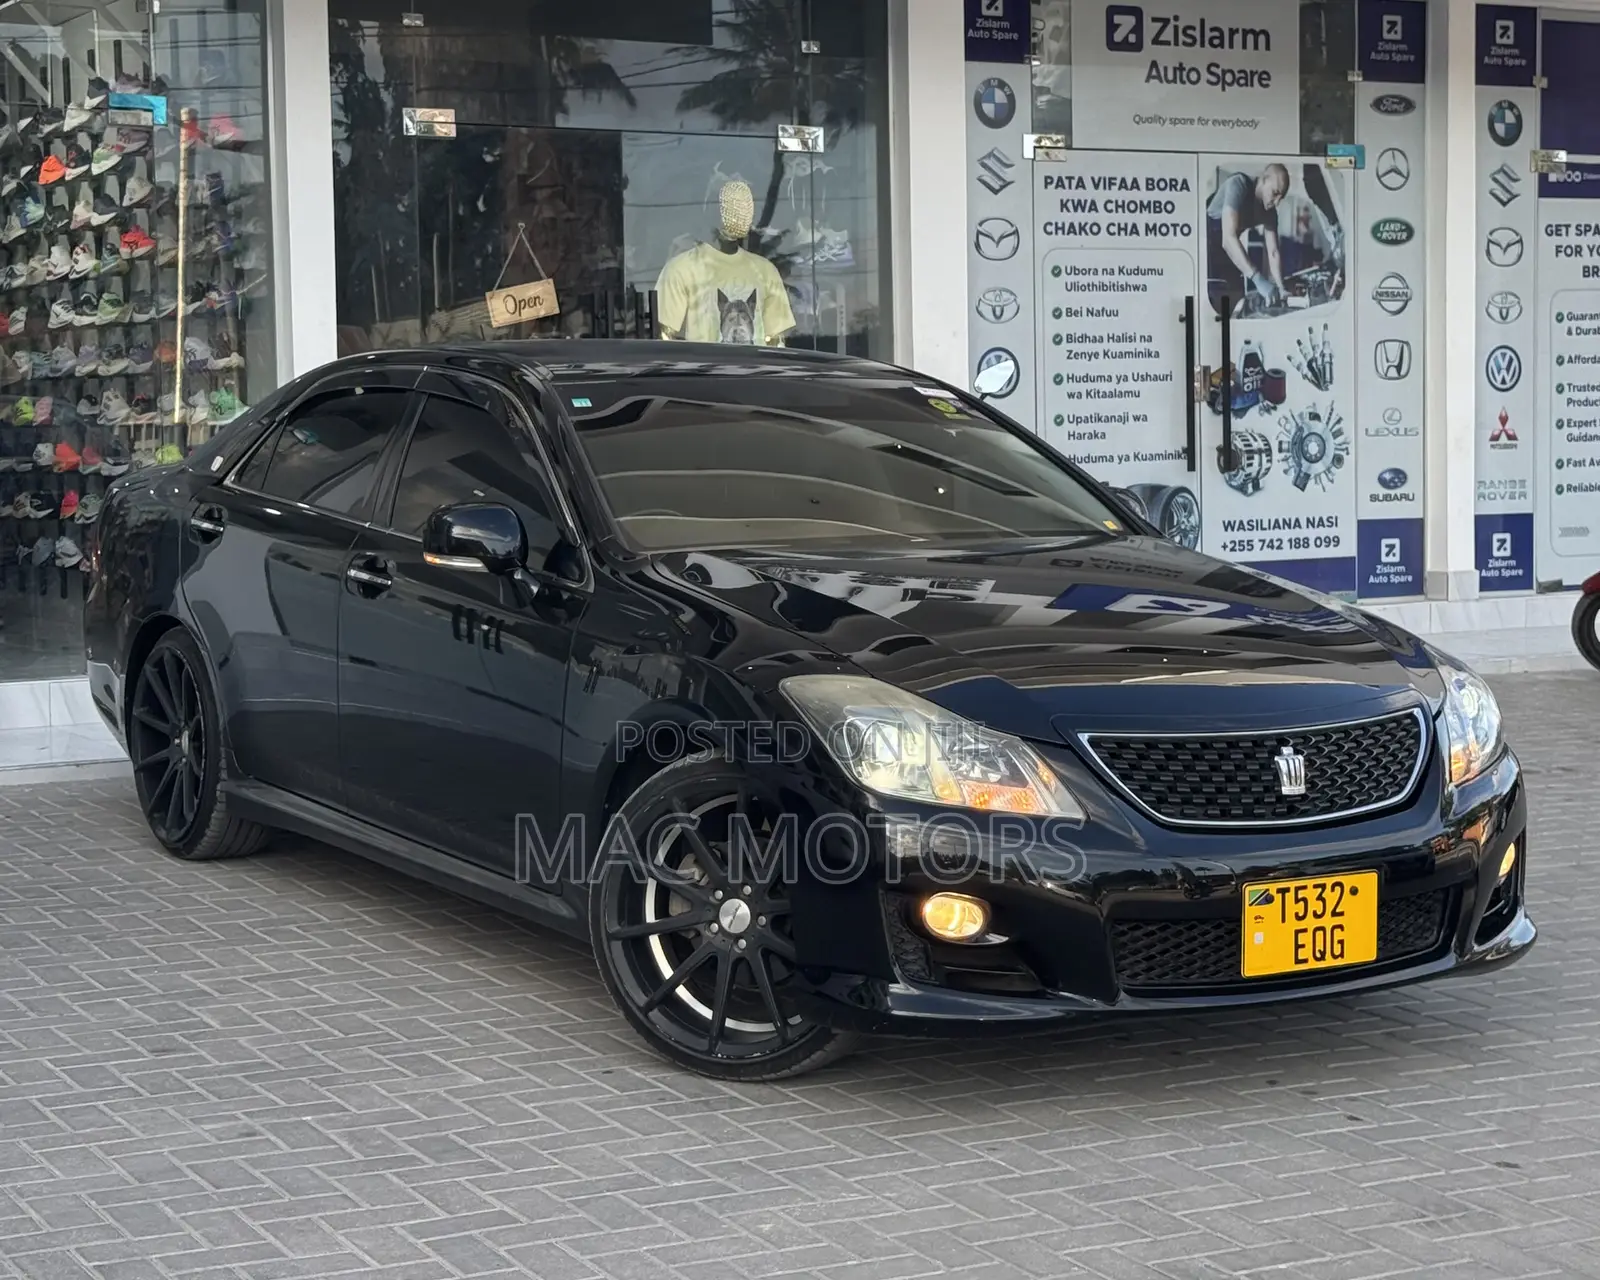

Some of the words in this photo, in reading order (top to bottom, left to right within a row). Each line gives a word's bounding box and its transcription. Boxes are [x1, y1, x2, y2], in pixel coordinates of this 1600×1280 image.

[976, 18, 1010, 29] Zislarm
[968, 29, 990, 38] Auto
[992, 30, 1019, 40] Spare
[1151, 15, 1271, 51] Zislarm
[1378, 42, 1408, 52] Zislarm
[1490, 46, 1520, 56] Zislarm
[1370, 52, 1390, 60] Auto
[1392, 52, 1416, 62] Spare
[1484, 56, 1502, 65] Auto
[1504, 57, 1526, 66] Spare
[1145, 60, 1201, 86] Auto
[1206, 62, 1272, 92] Spare
[1133, 114, 1168, 127] Quality
[1168, 116, 1195, 126] spare
[1197, 116, 1210, 126] for
[1212, 117, 1260, 130] everybody
[1044, 175, 1086, 190] PATA
[1090, 176, 1140, 192] VIFAA
[1145, 178, 1190, 192] BORA
[1060, 198, 1099, 213] KWA
[1104, 200, 1175, 214] CHOMBO
[1043, 222, 1102, 236] CHAKO
[1106, 222, 1140, 236] CHA
[1145, 222, 1192, 237] MOTO
[1380, 222, 1401, 232] LAND
[1544, 224, 1571, 236] GET
[1382, 232, 1408, 240] ROVER
[1555, 244, 1582, 258] FOR
[1064, 265, 1098, 276] Ubora
[1118, 266, 1164, 276] Kudumu
[1064, 282, 1148, 292] Uliothibitishwa
[502, 294, 544, 316] Open
[1065, 306, 1083, 318] Bei
[1086, 307, 1119, 318] Nafuu
[1566, 326, 1573, 336] &
[1066, 332, 1104, 344] Bidhaa
[1107, 332, 1136, 343] Halisi
[1066, 350, 1100, 362] Zenye
[1103, 348, 1160, 359] Kuaminika
[1066, 373, 1112, 384] Huduma
[1116, 375, 1128, 385] ya
[1132, 370, 1173, 382] Ushauri
[1086, 388, 1140, 399] Kitaalamu
[1566, 397, 1600, 408] Produc
[1067, 412, 1129, 426] Upatikanaji
[1132, 414, 1148, 422] wa
[1566, 417, 1597, 430] Expert
[1067, 430, 1106, 440] Haraka
[1365, 427, 1419, 437] LEXUS
[1068, 452, 1114, 464] Huduma
[1117, 454, 1130, 465] ya
[1566, 458, 1586, 468] Fast
[1477, 480, 1527, 490] RANGE
[1369, 493, 1415, 502] SUBARU
[1477, 491, 1528, 501] ROVER
[1222, 517, 1302, 532] WASILIANA
[1306, 516, 1338, 528] NASI
[1221, 540, 1254, 553] +255
[1260, 538, 1284, 551] 742
[1287, 537, 1310, 550] 188
[1314, 536, 1340, 548] 099
[1488, 559, 1517, 568] Zislarm
[1376, 565, 1406, 574] Zislarm
[1481, 568, 1499, 577] Auto
[1500, 568, 1523, 578] Spare
[1368, 575, 1388, 583] Auto
[1390, 574, 1412, 583] Spare
[1276, 881, 1345, 924] T532
[1294, 924, 1345, 965] EQG
